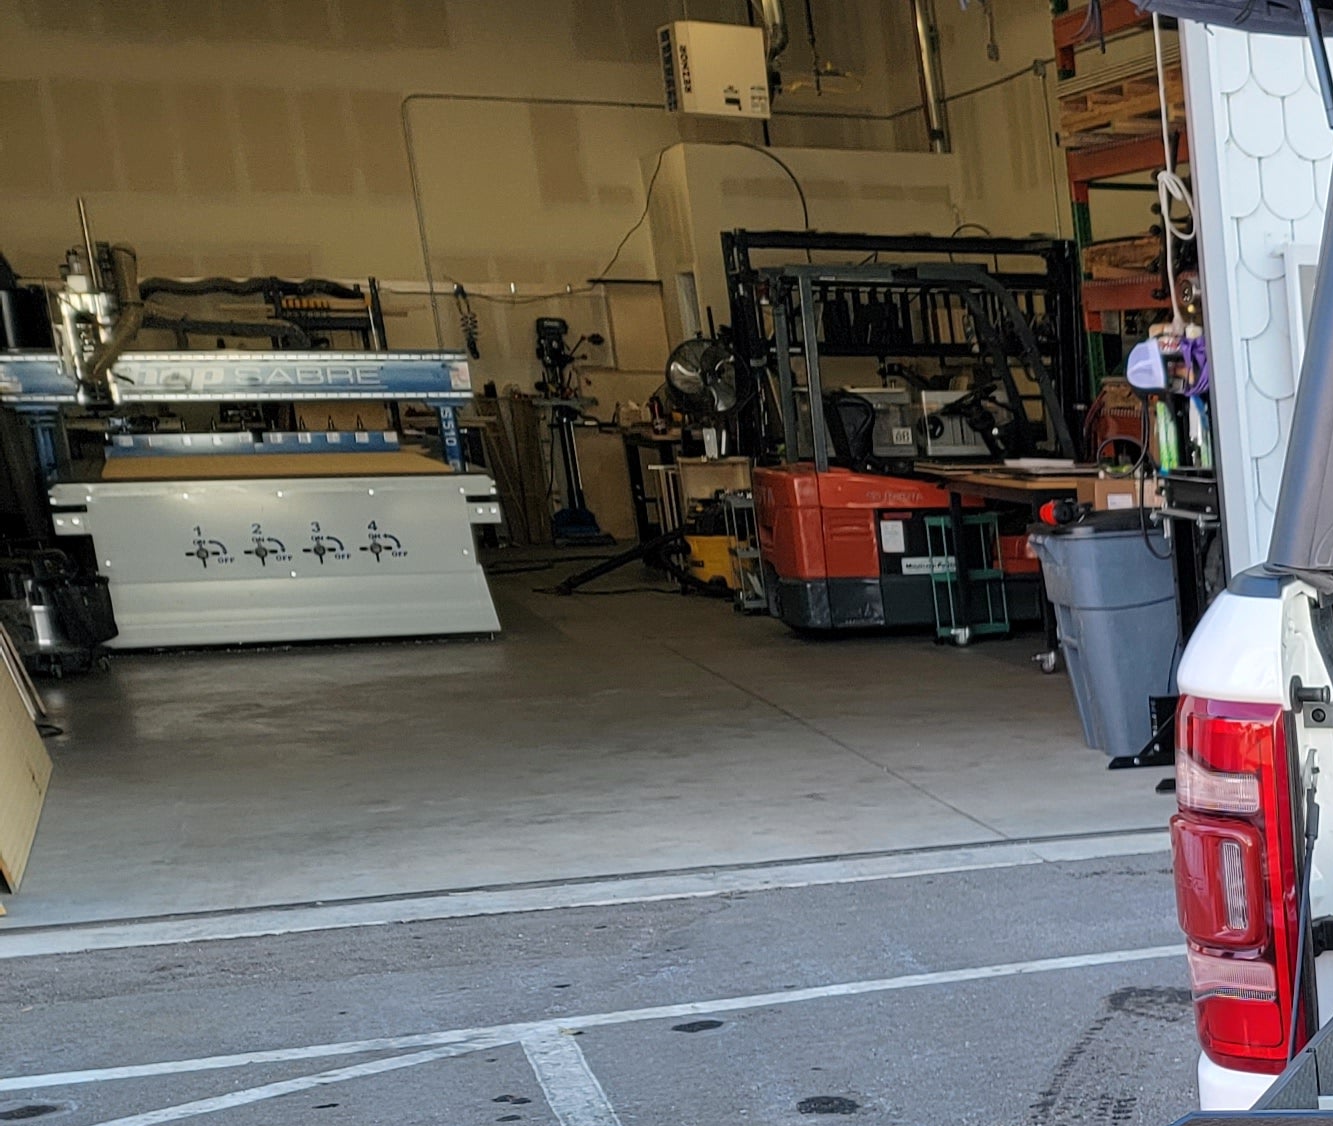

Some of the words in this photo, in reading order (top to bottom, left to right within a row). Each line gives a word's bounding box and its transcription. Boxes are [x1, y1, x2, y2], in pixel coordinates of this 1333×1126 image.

[235, 366, 381, 386] SABRE
[193, 525, 201, 537] 1
[252, 523, 262, 535] 2
[311, 521, 321, 533] 3
[368, 520, 378, 531] 4
[218, 556, 235, 564] OFF
